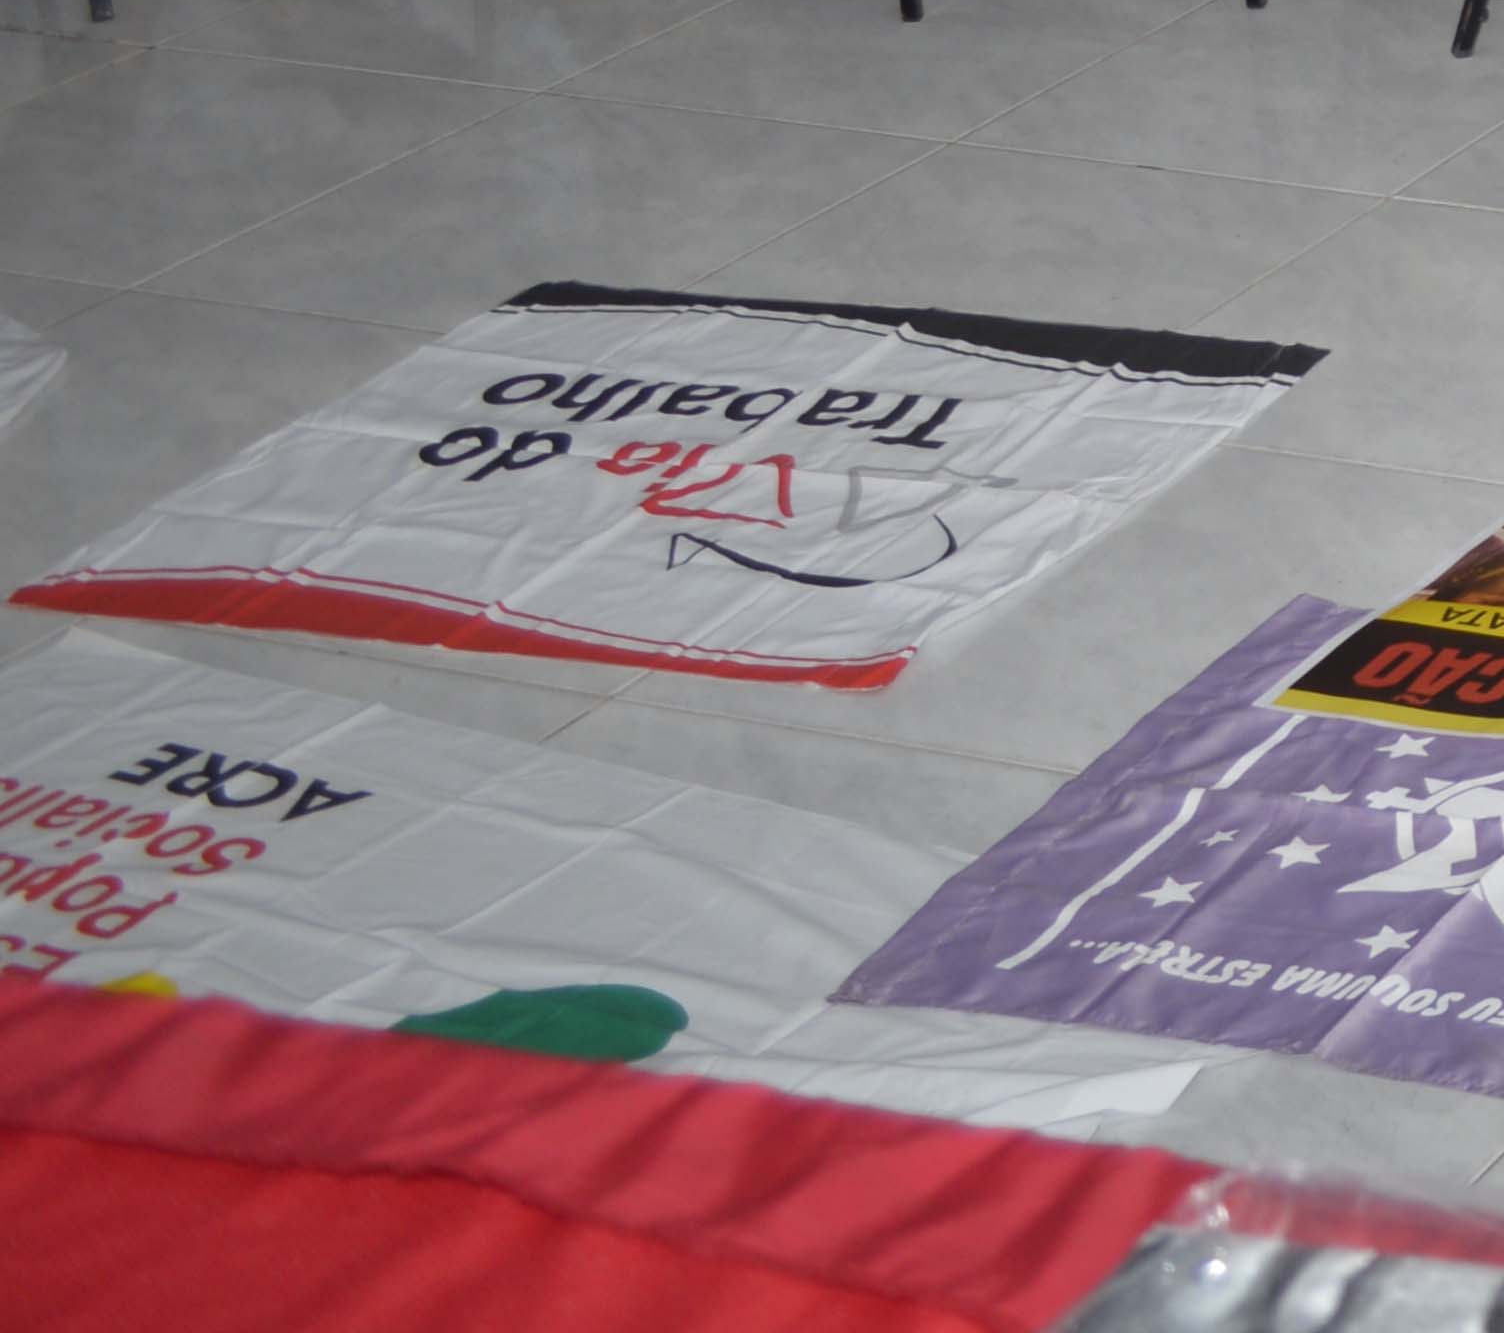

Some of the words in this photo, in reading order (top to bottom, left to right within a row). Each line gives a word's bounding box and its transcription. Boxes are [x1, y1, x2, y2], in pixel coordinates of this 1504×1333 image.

[482, 372, 963, 449] Trabalho
[418, 426, 573, 482] do
[106, 742, 375, 823] ACRE
[1272, 966, 1370, 1000] UMA
[1369, 975, 1455, 1018] SOU
